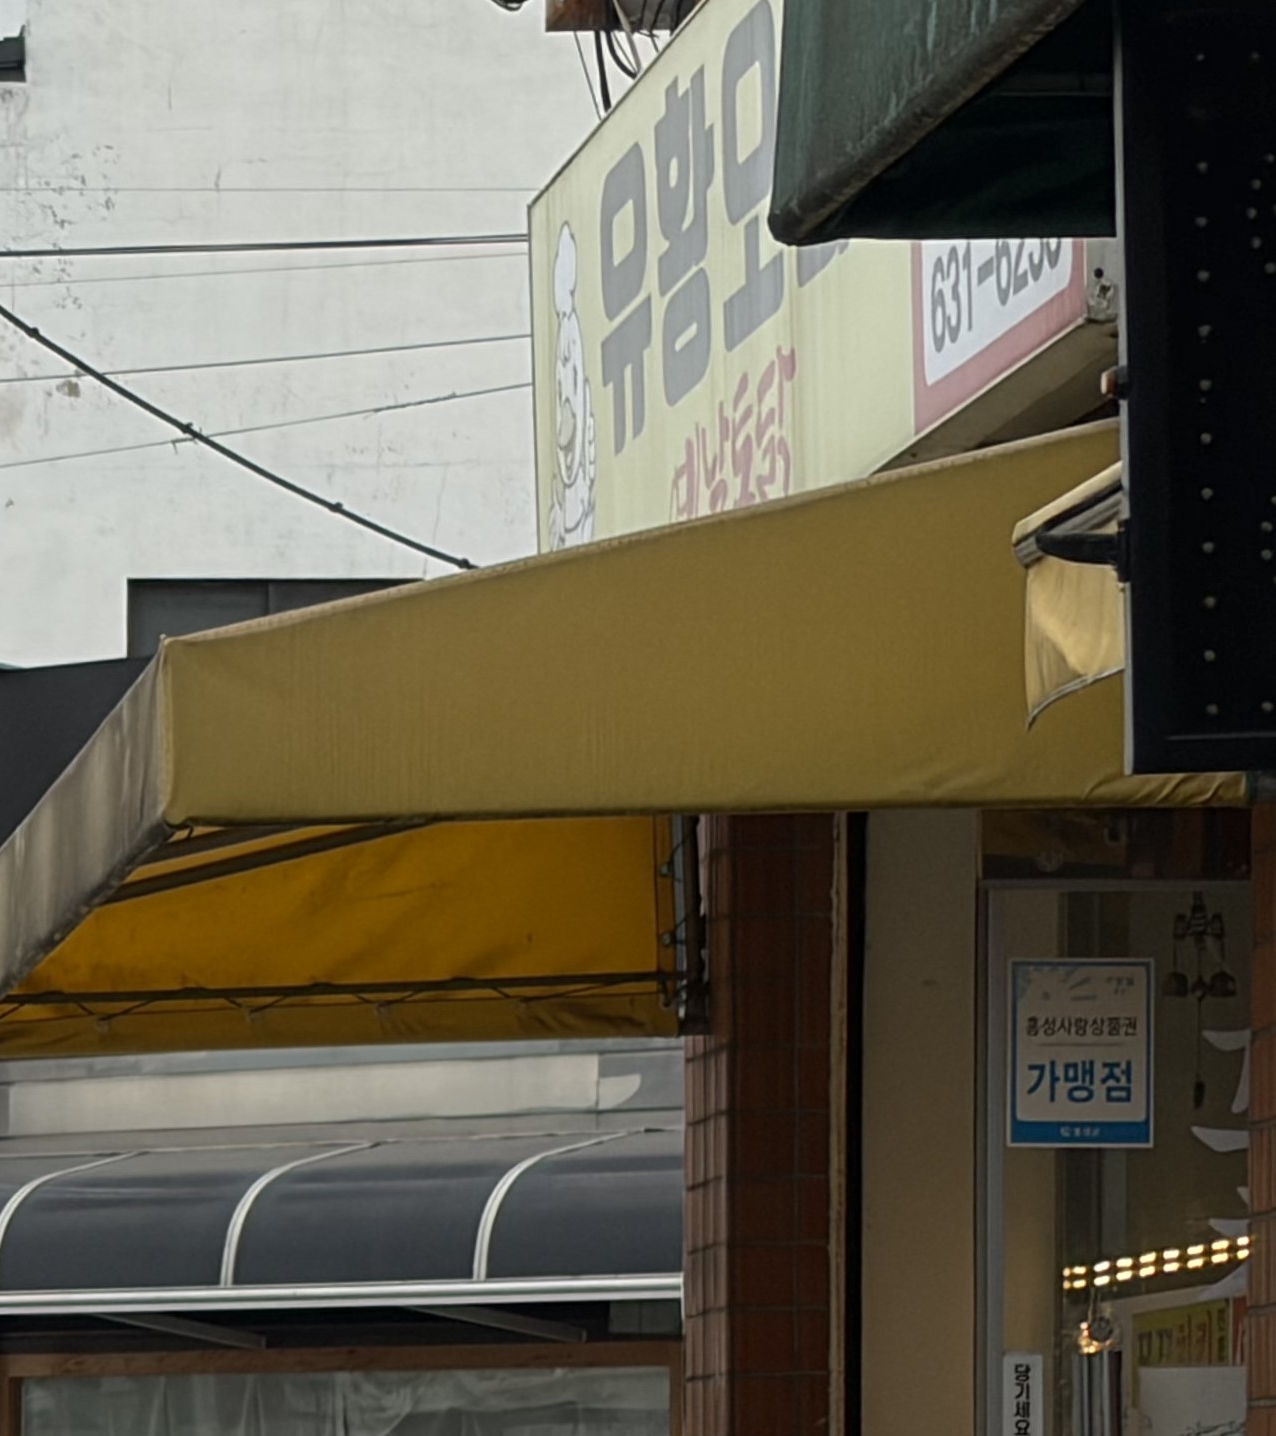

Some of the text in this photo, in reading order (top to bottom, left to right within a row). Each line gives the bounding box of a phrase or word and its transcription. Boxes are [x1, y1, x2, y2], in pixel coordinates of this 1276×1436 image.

[600, 0, 849, 455] 유황오
[1025, 1016, 1138, 1038] 홍성사랑상품권
[1026, 1058, 1134, 1105] 가맹점
[1014, 1363, 1032, 1436] 당기세요
